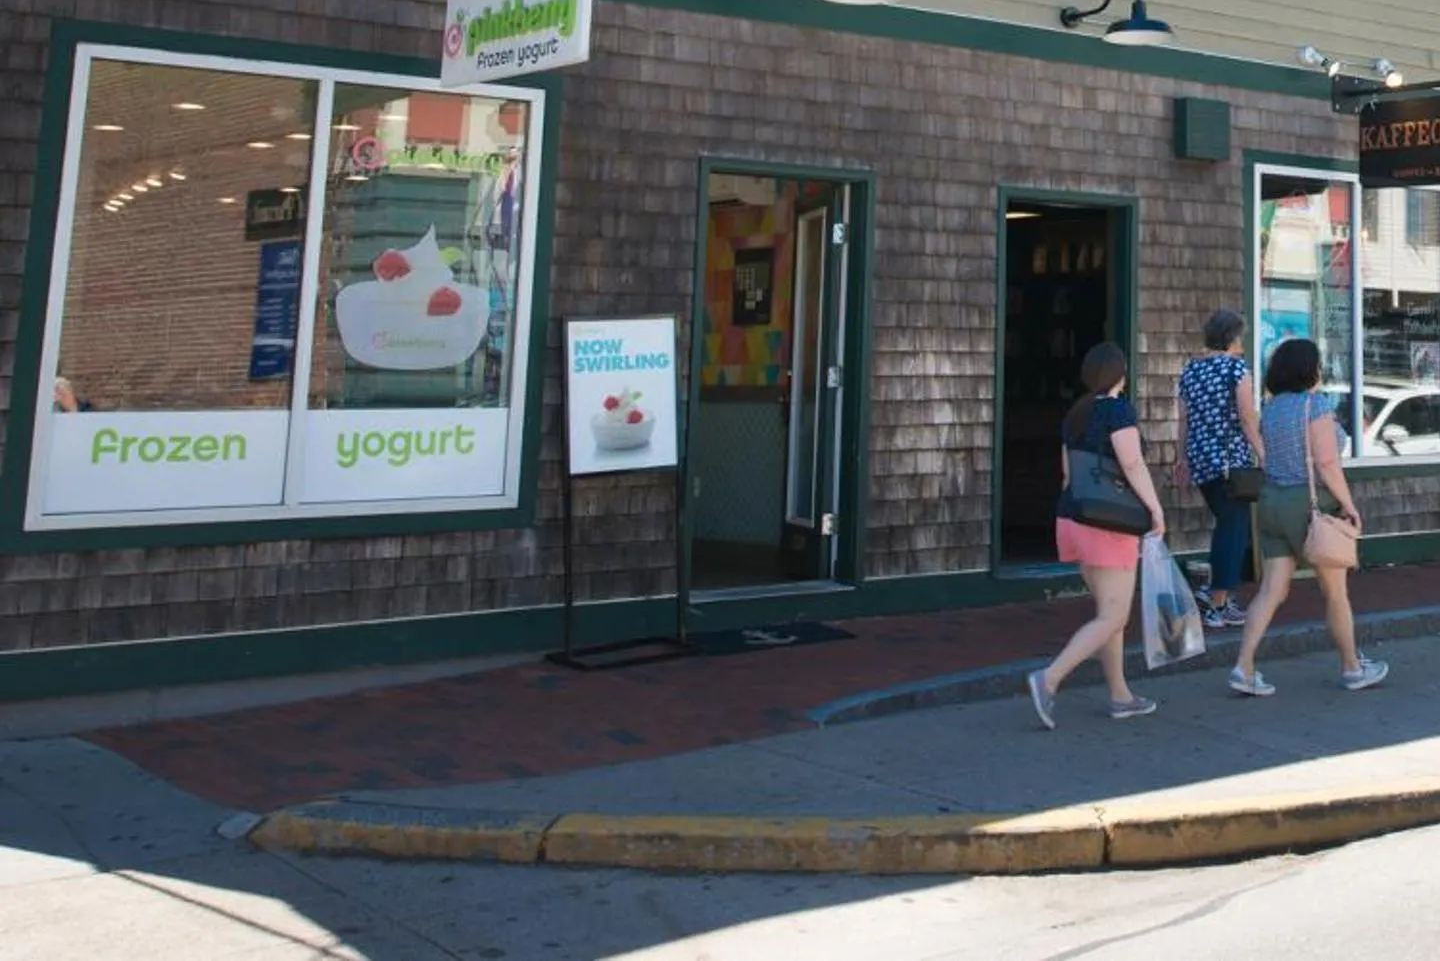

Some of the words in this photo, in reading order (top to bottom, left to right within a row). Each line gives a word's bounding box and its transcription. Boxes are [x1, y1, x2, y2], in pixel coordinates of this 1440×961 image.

[477, 48, 515, 69] frozen
[518, 37, 559, 67] yogurt
[574, 338, 622, 356] NOW
[574, 353, 670, 374] SWIRLING
[91, 427, 247, 465] frozen
[337, 423, 475, 468] yogurt
